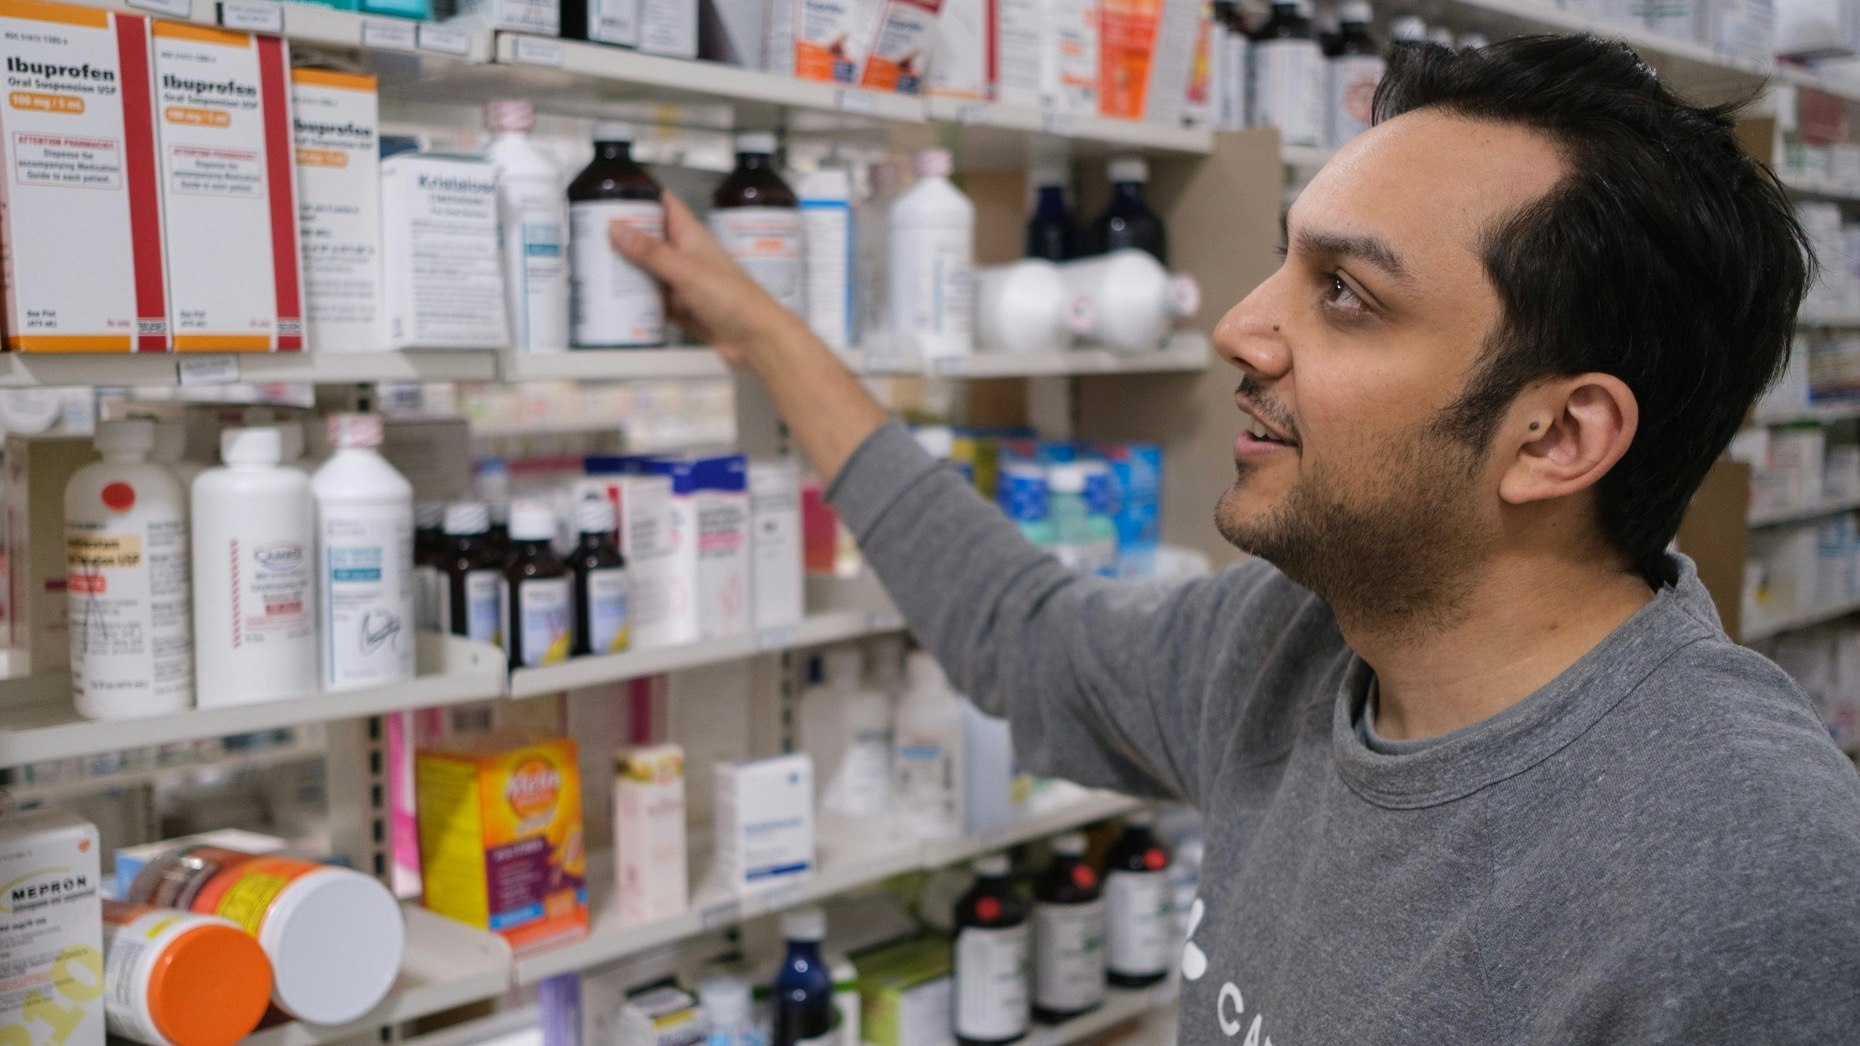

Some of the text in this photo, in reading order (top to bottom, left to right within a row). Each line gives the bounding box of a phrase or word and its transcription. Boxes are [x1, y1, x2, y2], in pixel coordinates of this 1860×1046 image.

[7, 57, 115, 81] Ibuprofen
[8, 76, 116, 95] Oral Suspension USP
[163, 73, 257, 96] Ibuprofen
[188, 94, 239, 108] Suspension
[293, 118, 373, 136] buprofen
[19, 136, 61, 147] ATTENTION
[44, 148, 94, 160] Dispense the
[19, 161, 119, 172] accompanying Medication
[27, 170, 50, 180] Guide
[63, 173, 80, 181] each
[12, 876, 88, 901] MEPRON
[1217, 981, 1274, 1046] CA
